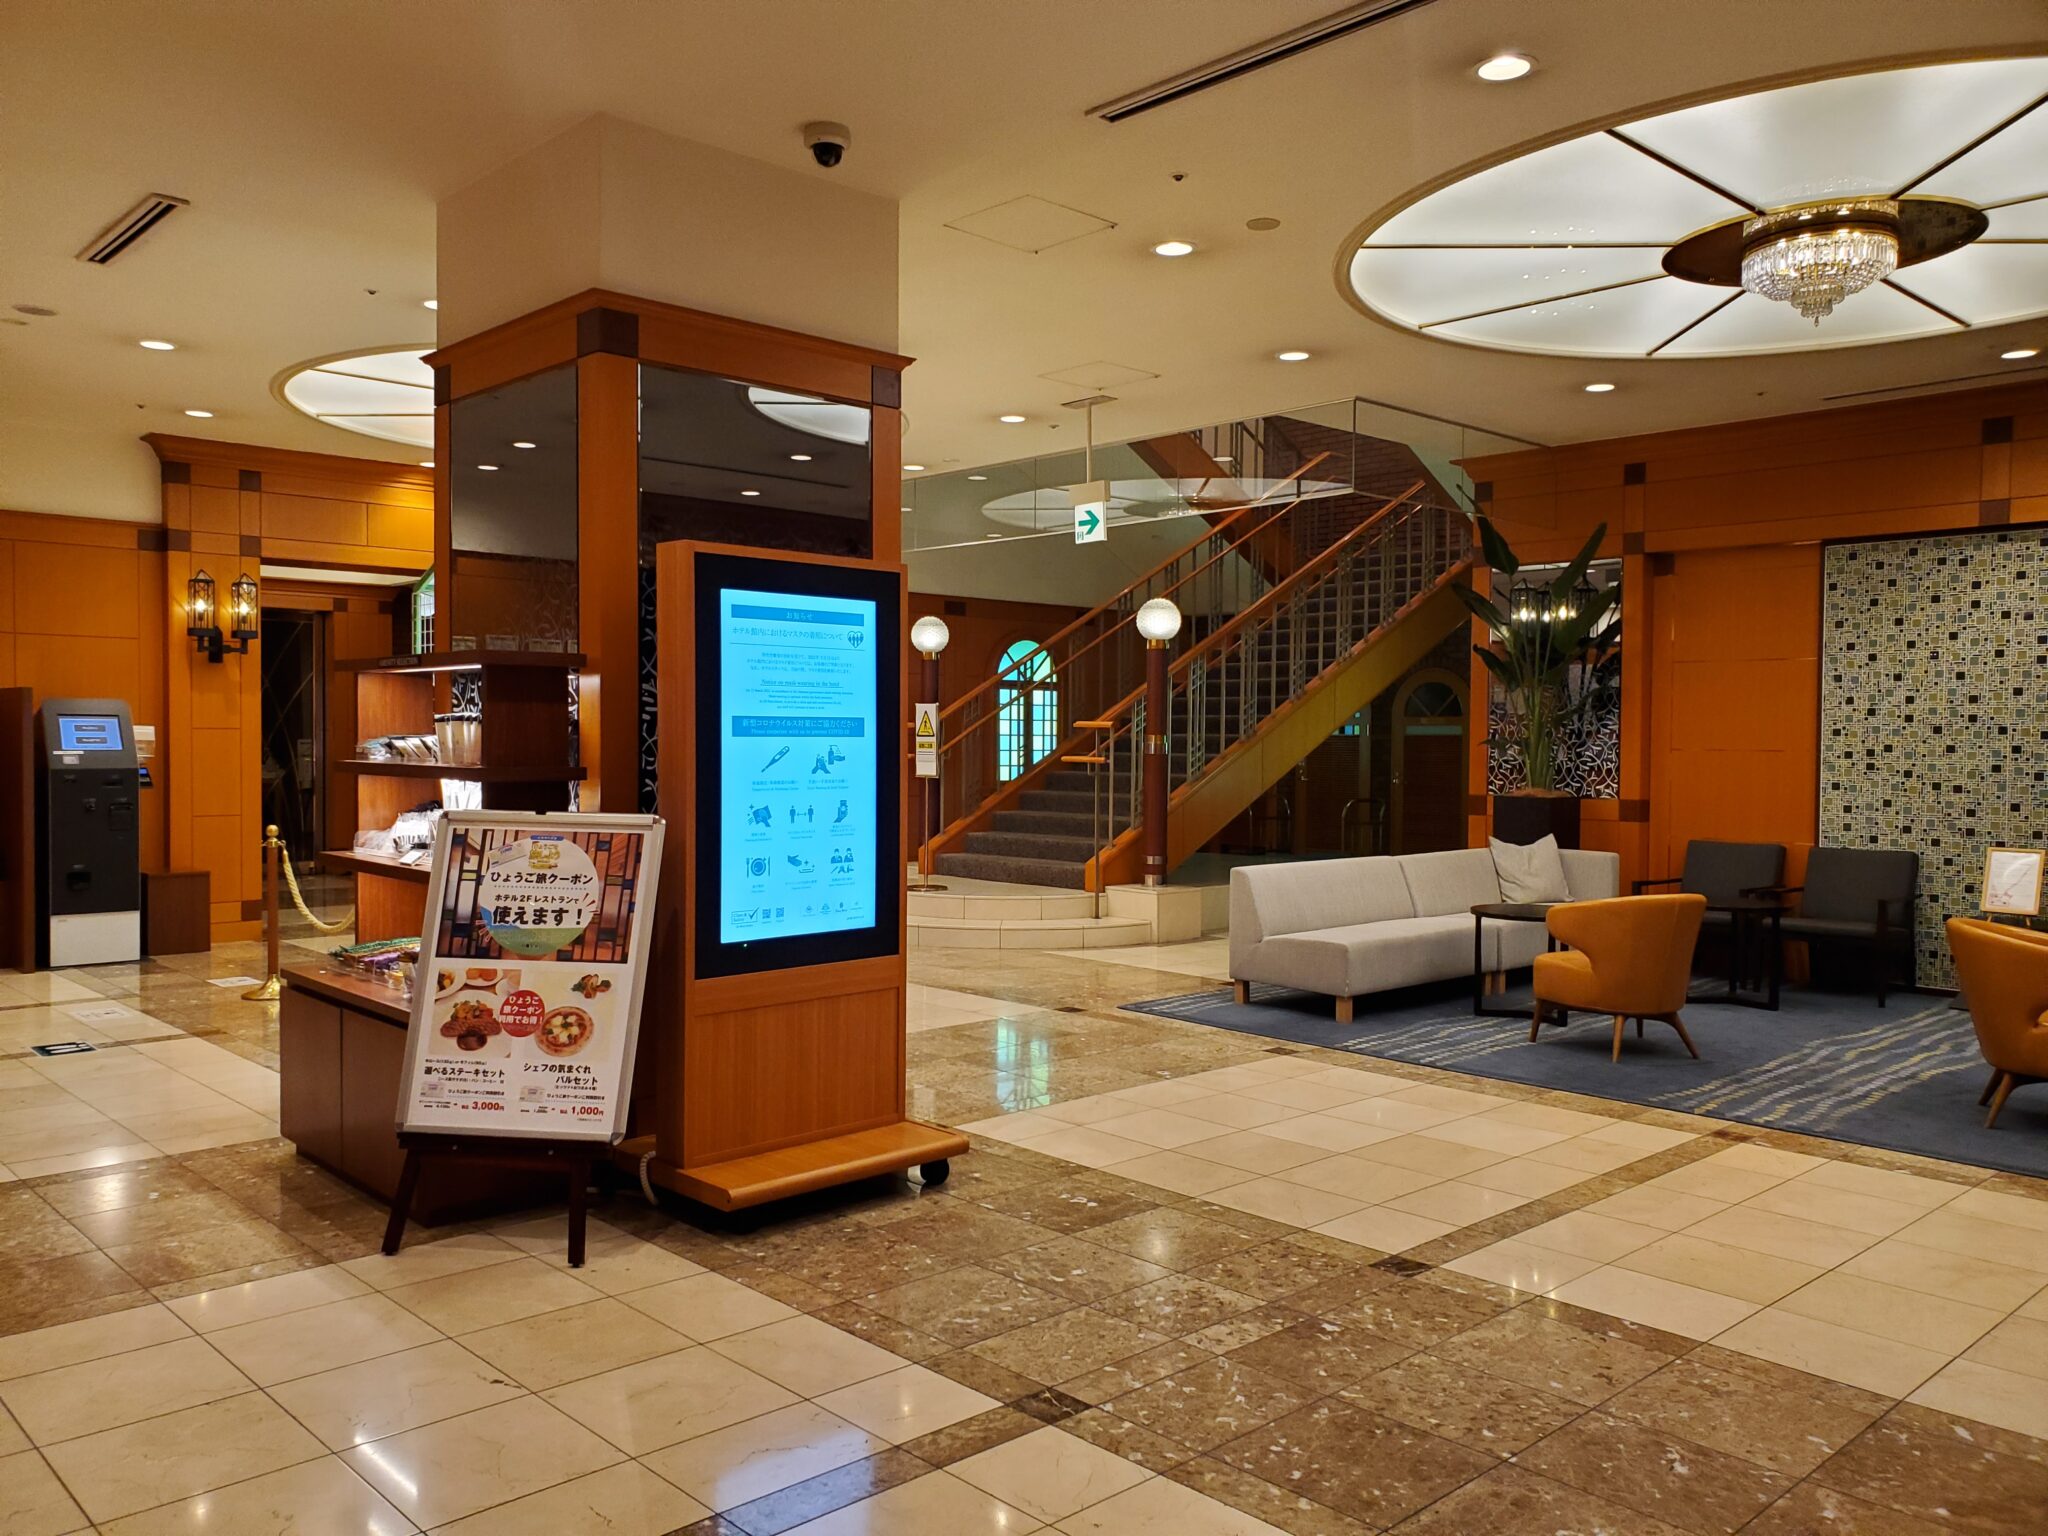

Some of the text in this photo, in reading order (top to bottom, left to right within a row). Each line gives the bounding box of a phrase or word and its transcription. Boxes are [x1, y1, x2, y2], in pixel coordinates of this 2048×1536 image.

[786, 611, 813, 621] お知らせ
[490, 872, 594, 885] ひょうご旅クーポン
[509, 995, 540, 1005] ひょうご
[424, 1066, 505, 1078] 選べるステーキセット
[523, 1063, 592, 1074] シェフの気まぐれ
[472, 1101, 505, 1111] 3,000円
[571, 1106, 604, 1116] 1,000円
